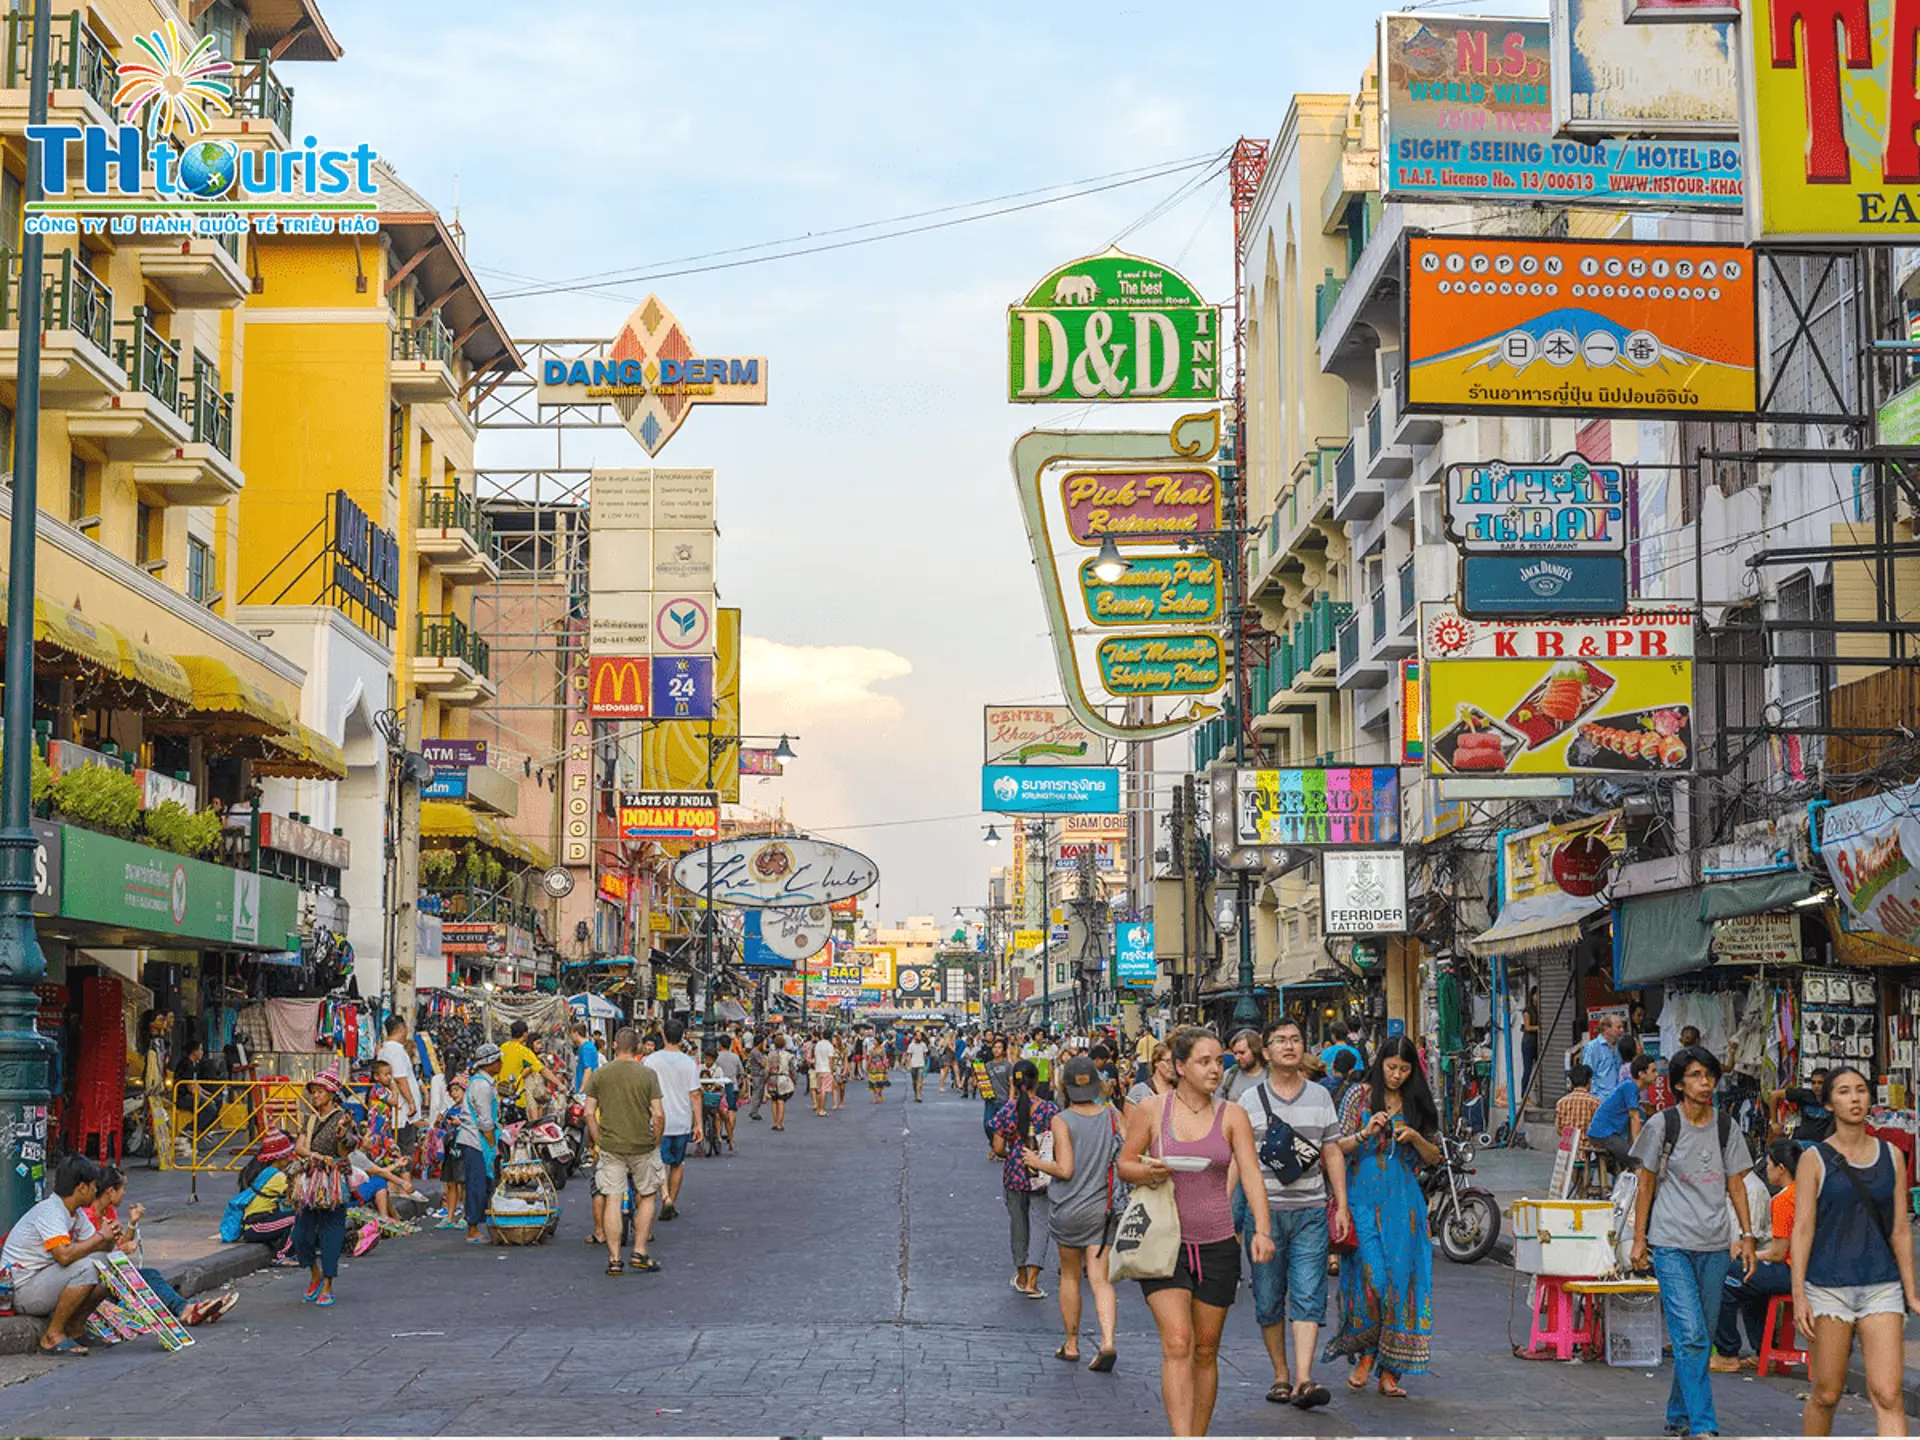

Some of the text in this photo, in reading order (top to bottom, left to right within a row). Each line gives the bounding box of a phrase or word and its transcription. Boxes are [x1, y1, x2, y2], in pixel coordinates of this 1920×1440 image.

[1456, 30, 1540, 76] N.S.
[1409, 82, 1548, 105] WORLD WIDE
[1437, 110, 1486, 132] JOIN
[1400, 139, 1462, 163] SIGHT
[1468, 141, 1543, 164] SEEING
[1551, 145, 1608, 167] TOUR
[1637, 148, 1700, 169] HOTEL
[1398, 169, 1436, 186] T.A.T.
[1442, 169, 1488, 188] License
[1492, 171, 1515, 188] No.
[1522, 171, 1594, 192] 13/00613
[1421, 253, 1740, 279] NIPPON ICHIBAN
[1119, 280, 1163, 295] The best
[1439, 281, 1721, 300] JAPANESE RESTAURANT
[1166, 297, 1189, 305] Road
[1017, 311, 1181, 398] D&D
[1191, 311, 1214, 391] INN
[1508, 336, 1655, 361] 日本一番
[544, 359, 759, 386] DANG DERM
[586, 385, 646, 397] Authentic
[1468, 382, 1593, 408] ร้านอาหารญี่ปุ่น
[1069, 475, 1213, 507] Pick-Thai
[1087, 509, 1197, 534] Restaurant
[1172, 560, 1213, 584] Pool
[1096, 589, 1209, 618] Beauty Salon
[1102, 641, 1217, 665] Thai Massage
[669, 678, 696, 697] 24
[1110, 664, 1216, 689] Shopping Plaza
[592, 703, 645, 712] McDonald's
[989, 710, 1055, 724] CENTER
[423, 748, 453, 761] ATM
[1022, 778, 1106, 794] ธนาคารกรุงไทย
[626, 796, 713, 807] TASTE OF INDIA
[570, 775, 588, 860] FOOD
[622, 809, 715, 827] INDIAN FOOD
[1068, 817, 1098, 829] SIAM
[784, 864, 865, 892] Club
[1331, 909, 1402, 922] FERRIDER
[1332, 923, 1374, 931] TATTOO
[829, 967, 860, 977] BAG
